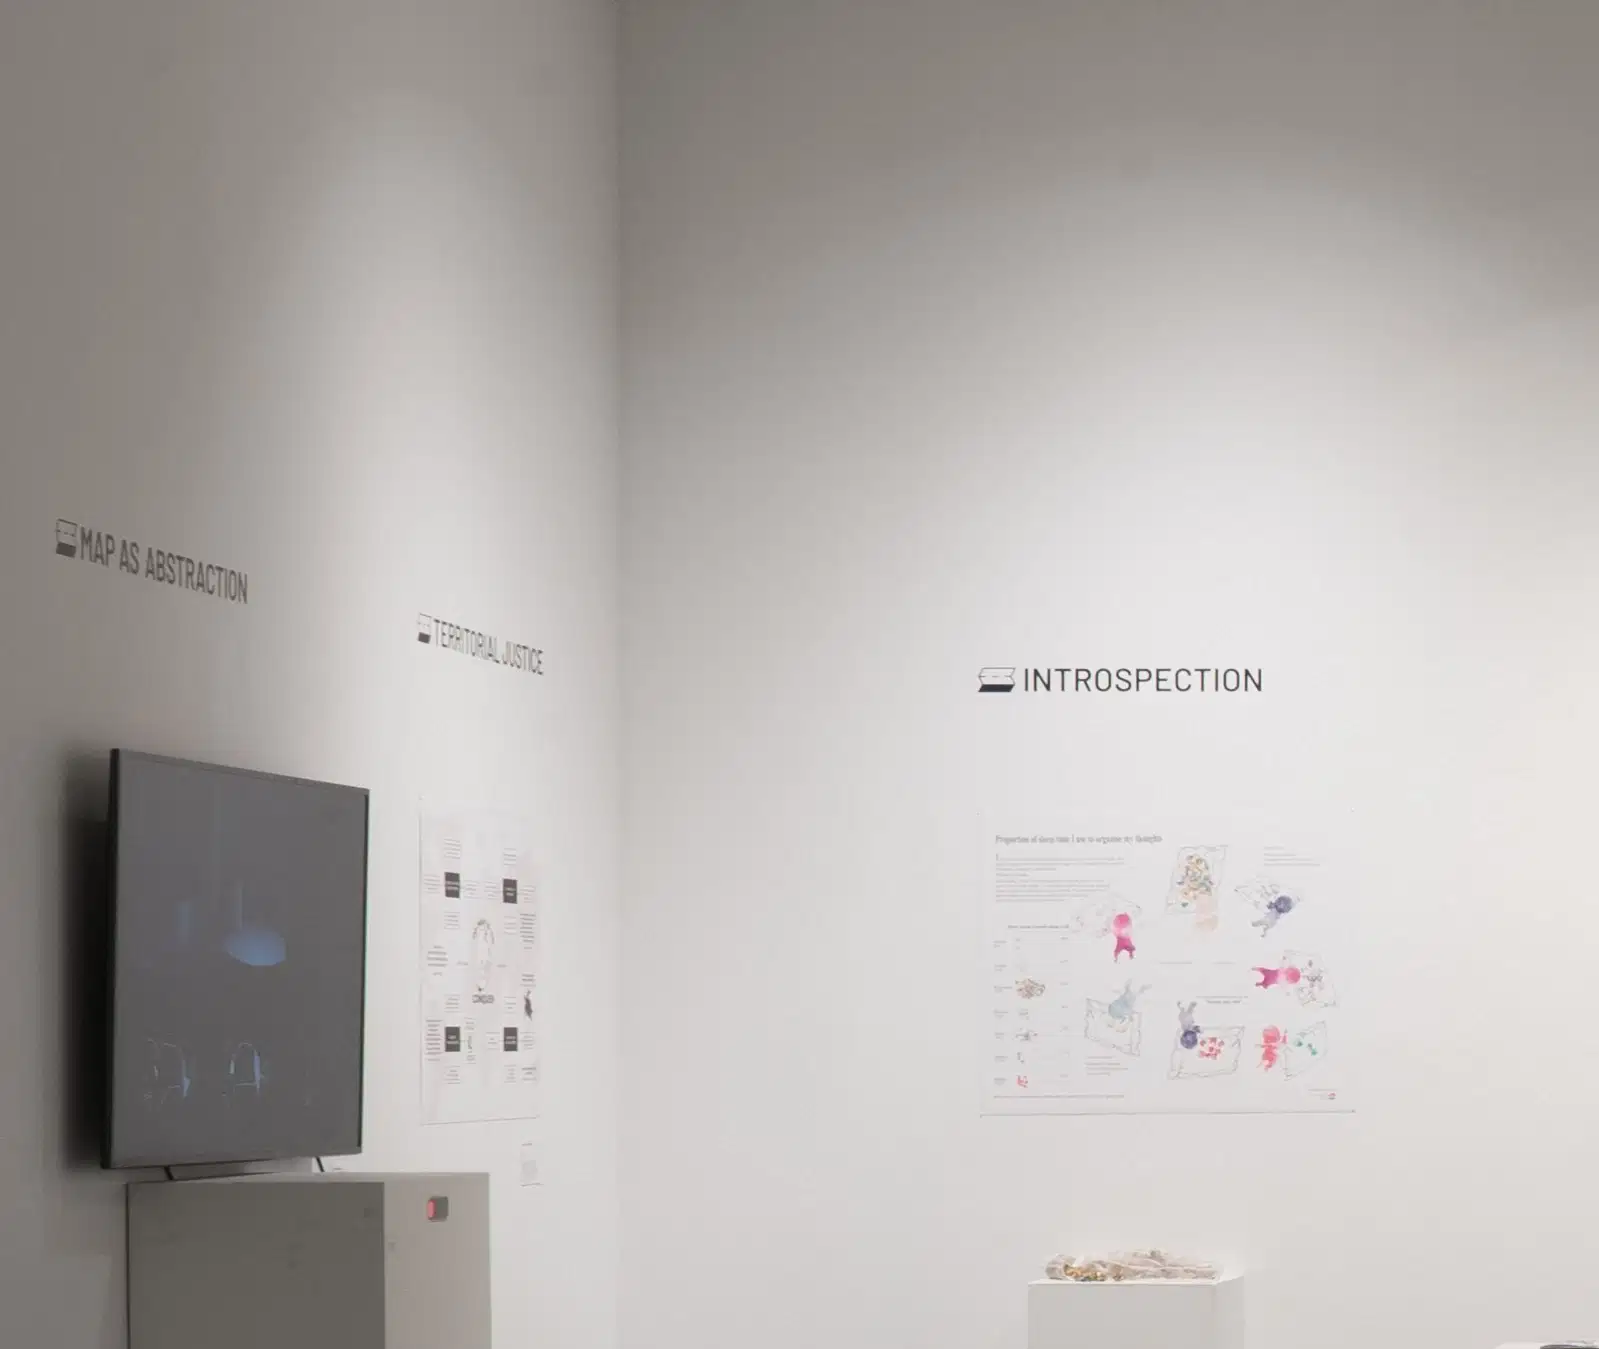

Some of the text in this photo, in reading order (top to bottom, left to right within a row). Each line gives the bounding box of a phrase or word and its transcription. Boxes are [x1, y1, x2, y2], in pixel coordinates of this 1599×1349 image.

[80, 526, 248, 604] MAP AS ABSTRACTION
[433, 618, 544, 676] TERRITORIAL JUSTICE
[1024, 668, 1263, 692] INTROSPECTION
